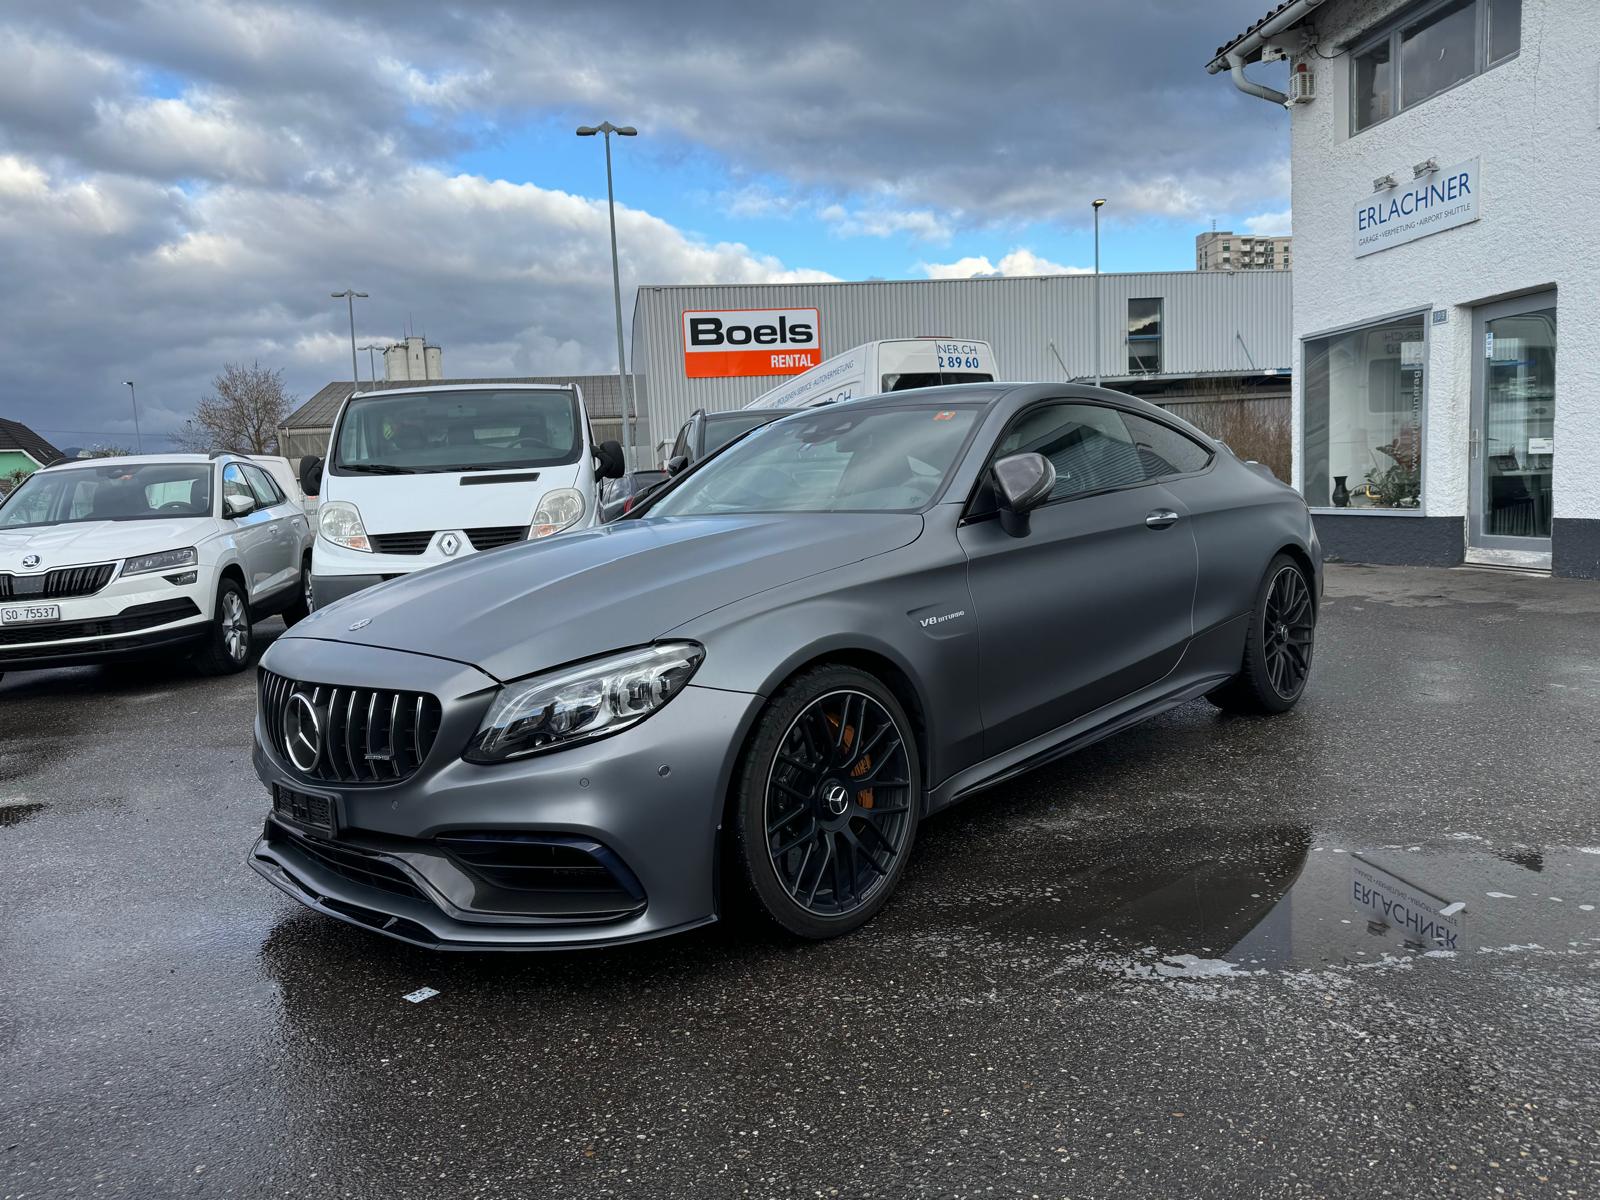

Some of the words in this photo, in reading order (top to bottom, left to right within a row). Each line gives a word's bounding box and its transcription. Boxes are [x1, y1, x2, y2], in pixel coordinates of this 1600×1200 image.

[1358, 173, 1471, 231] ERLACHNER
[1358, 234, 1379, 247] GARAGE
[1381, 221, 1416, 238] VERMIETUNG
[1418, 212, 1443, 226] AIRPORT
[1444, 202, 1471, 218] SHUTTLE
[689, 315, 813, 346] Boels
[938, 345, 977, 354] NER.CH
[771, 353, 814, 369] RENTAL
[948, 357, 962, 368] 89
[965, 358, 979, 369] 60
[23, 607, 55, 619] 75537
[920, 616, 937, 628] V8
[938, 610, 965, 623] BITURBO
